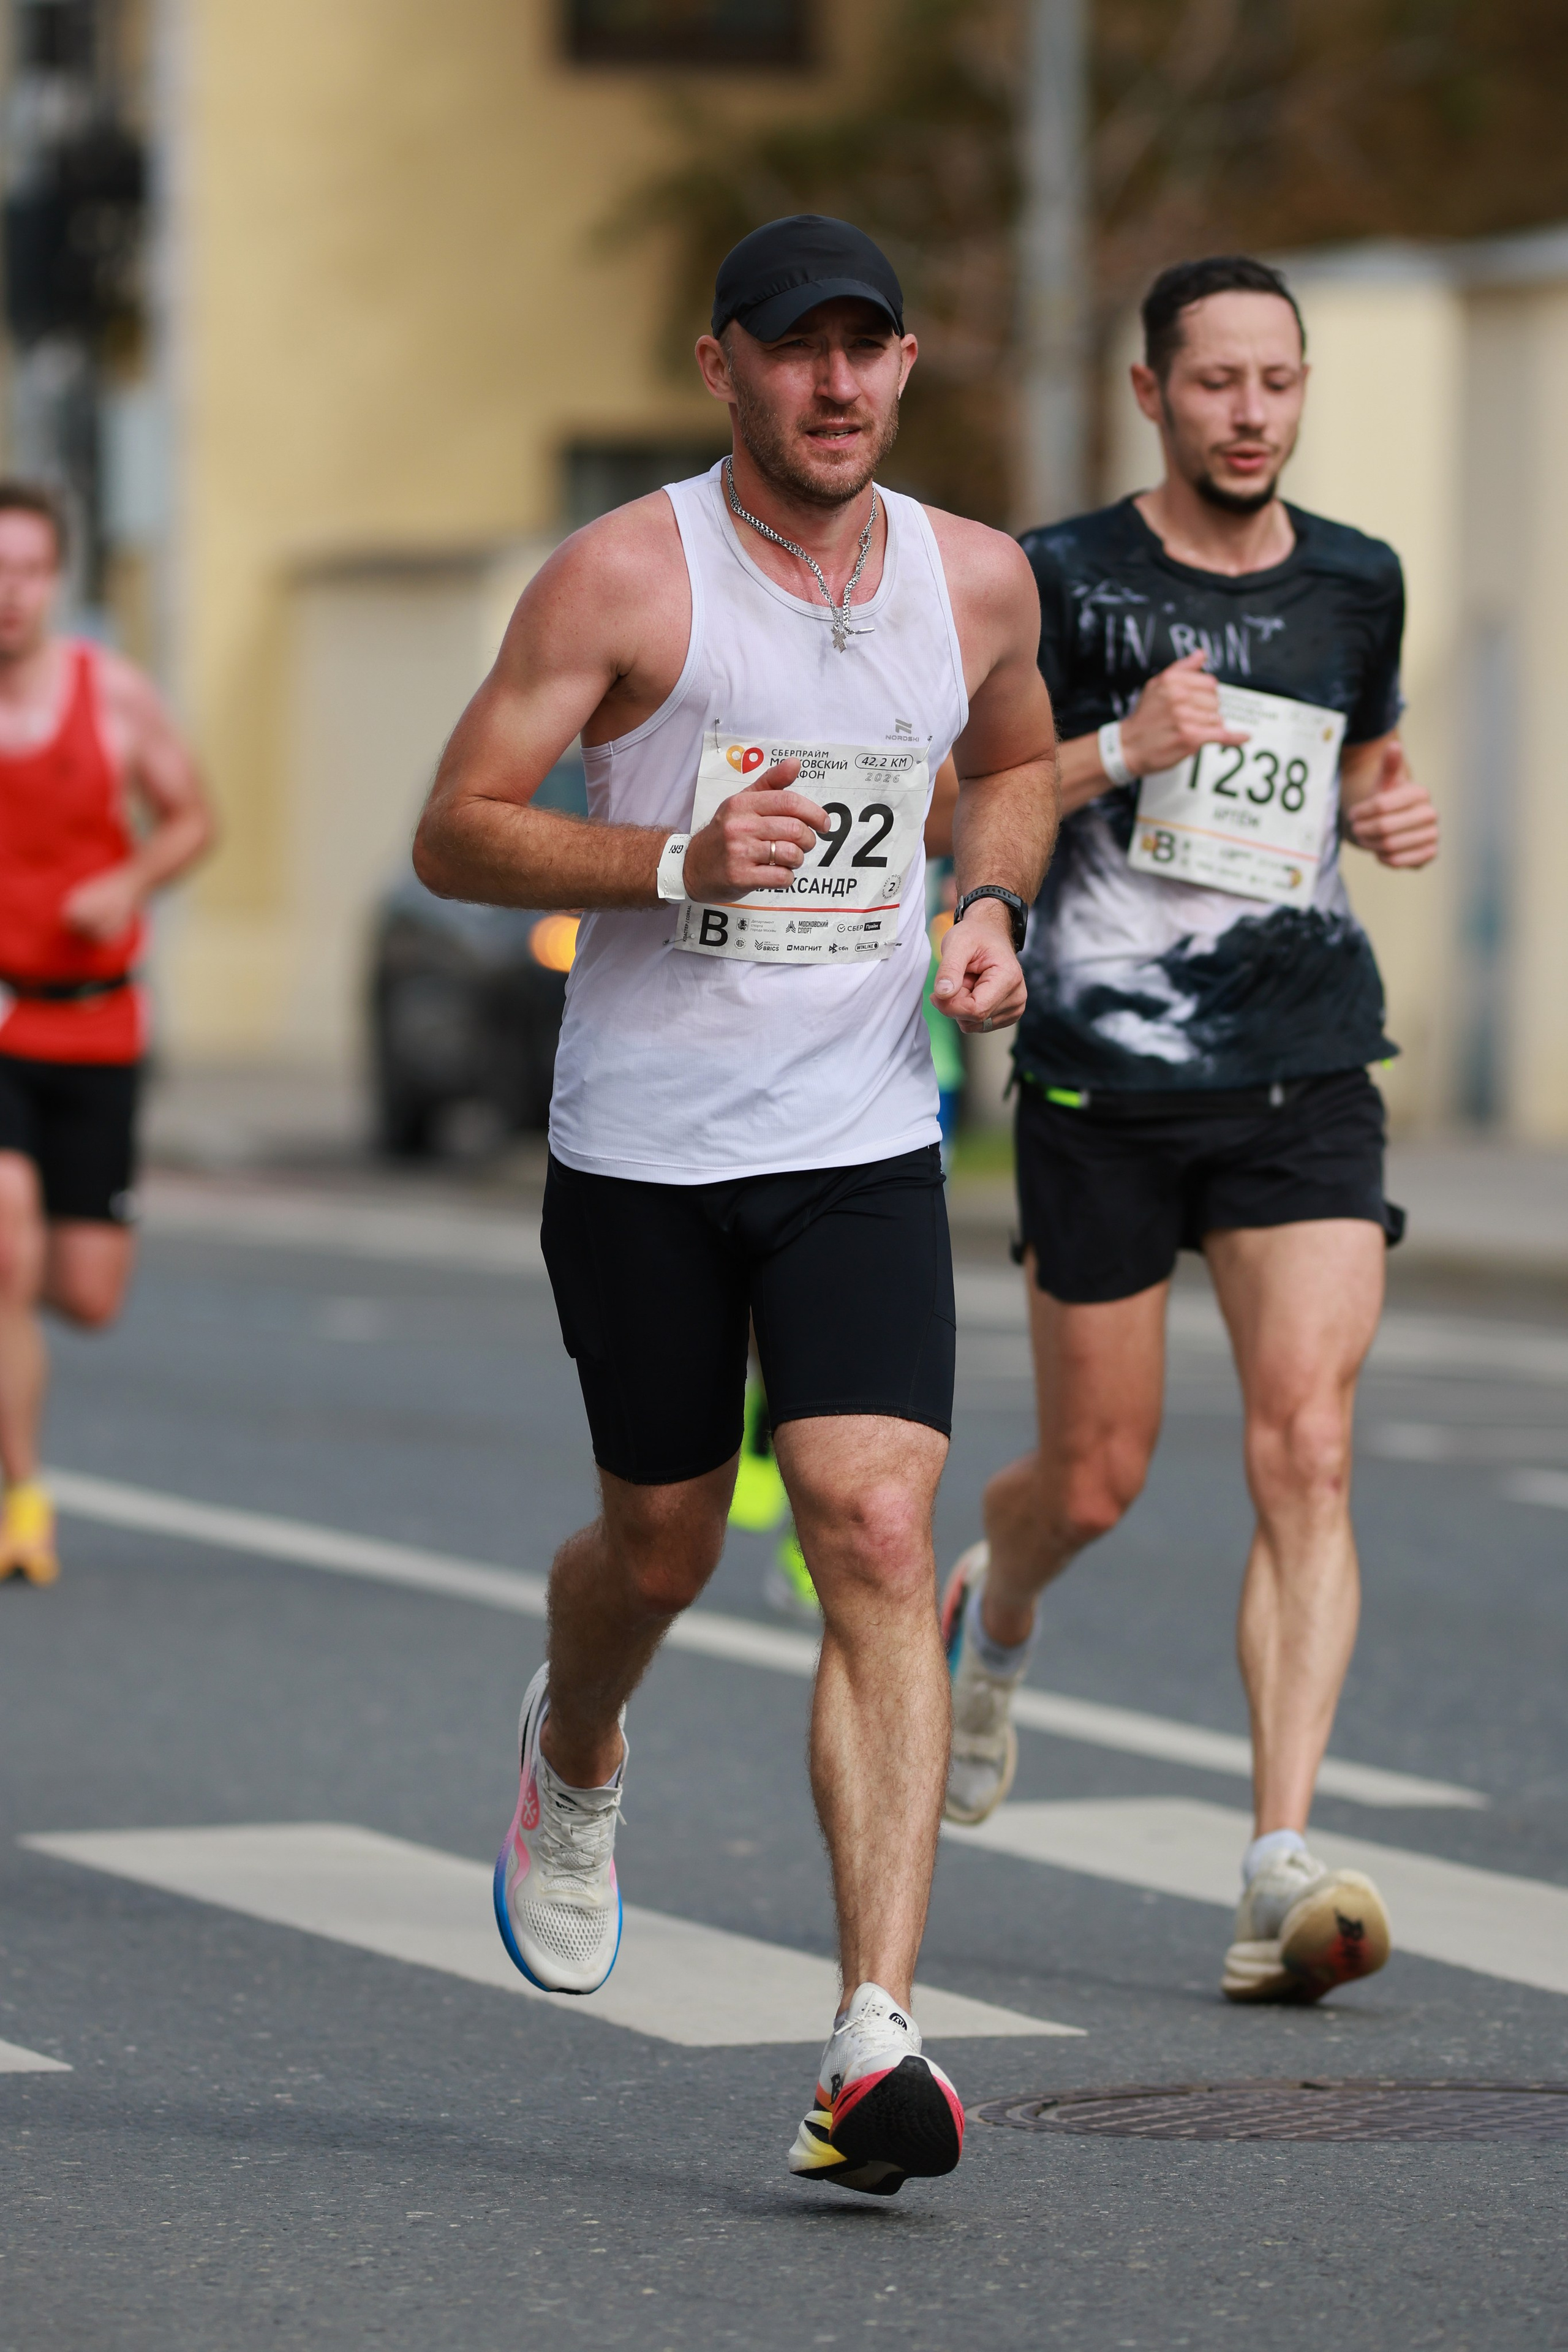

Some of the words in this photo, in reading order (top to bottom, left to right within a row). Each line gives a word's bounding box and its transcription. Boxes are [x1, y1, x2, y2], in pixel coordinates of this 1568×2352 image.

[1105, 613, 1156, 673] IN
[1169, 623, 1251, 676] RUN
[772, 748, 829, 758] СБЕРПРАЙМ
[770, 758, 848, 770] МОВСКИЙ
[861, 756, 887, 767] 42,2
[865, 772, 900, 783] 2026
[1189, 743, 1308, 813] 1238
[817, 802, 894, 868] 92
[755, 877, 858, 897] КСАНДР
[888, 882, 895, 892] 2
[699, 909, 728, 946] B
